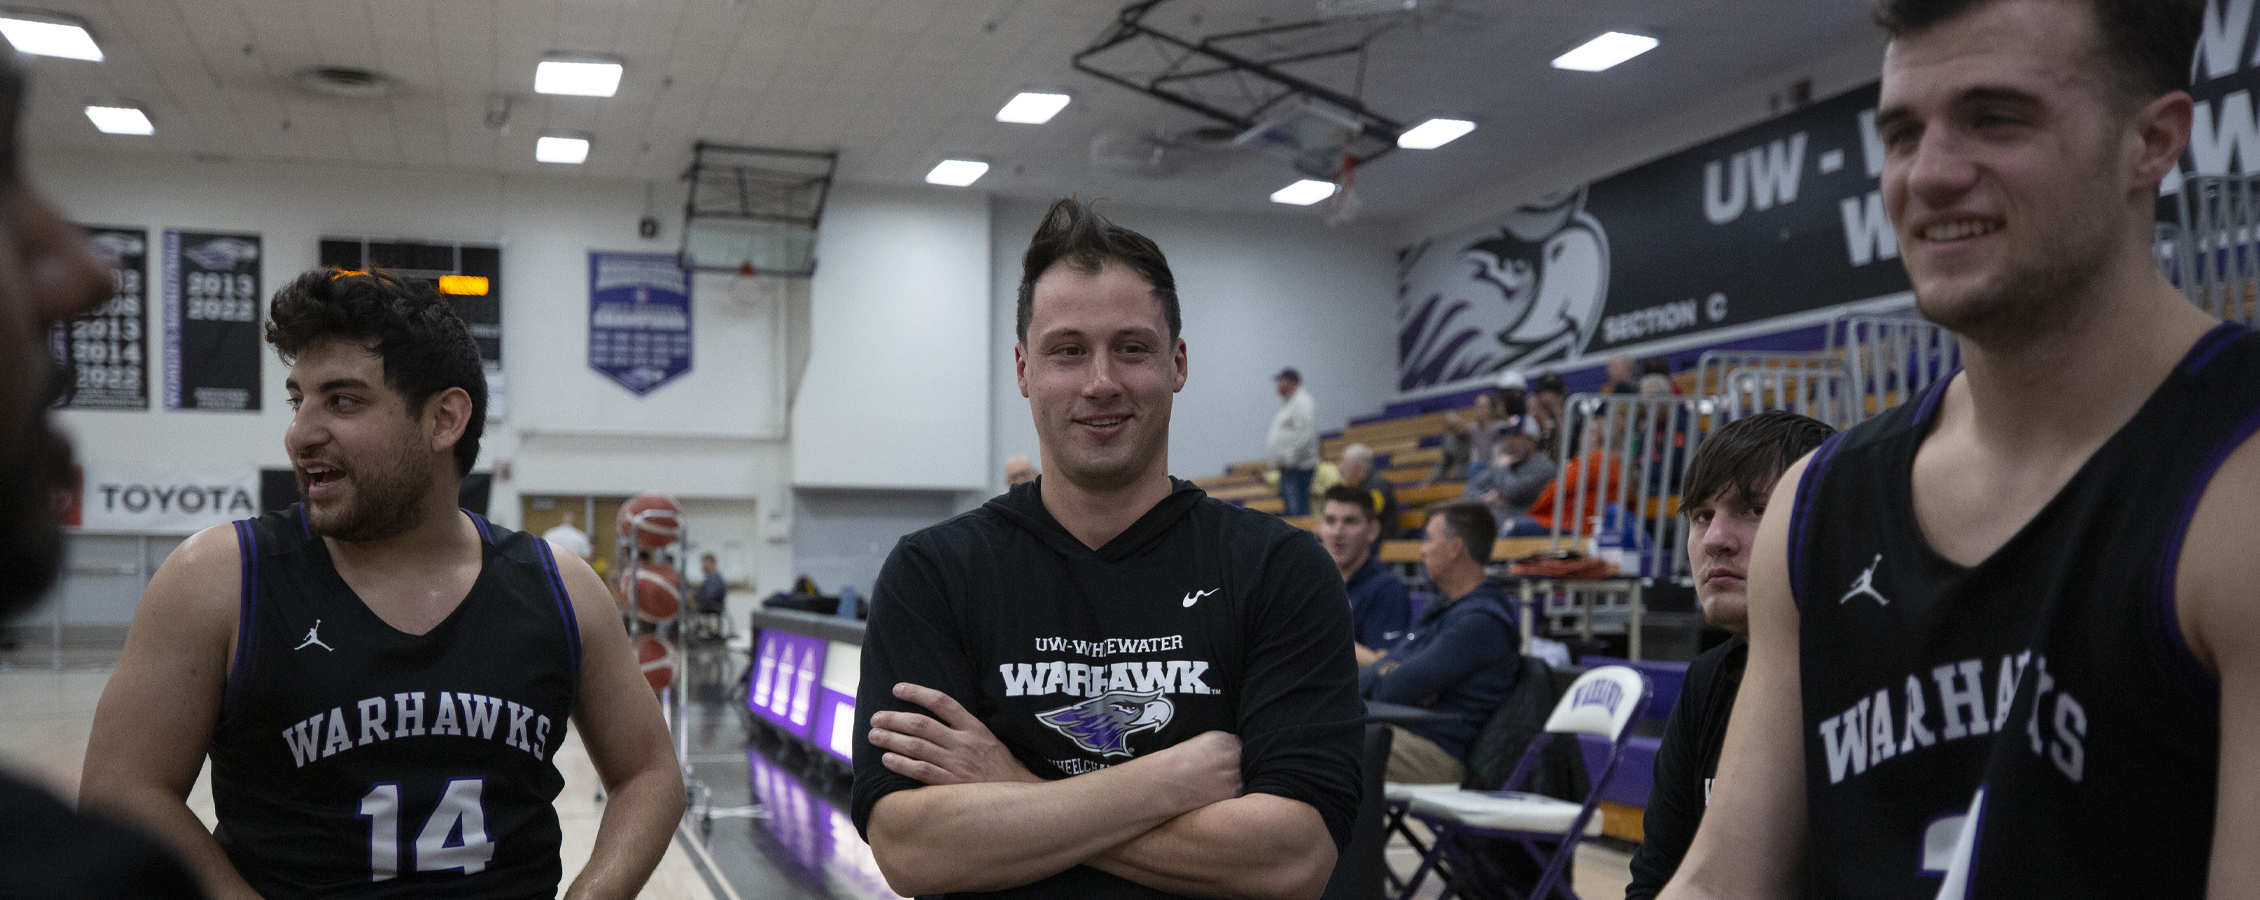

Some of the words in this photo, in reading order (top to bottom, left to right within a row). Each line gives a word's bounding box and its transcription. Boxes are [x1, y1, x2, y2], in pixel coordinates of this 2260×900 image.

[1703, 130, 1809, 225] UW
[186, 271, 255, 296] 2013
[1602, 299, 1698, 346] SECTION
[1704, 291, 1729, 323] C
[98, 483, 254, 513] TOYOTA
[1035, 634, 1183, 657] UW-WHEWATER
[282, 690, 551, 769] WARHAWKS
[1818, 648, 2088, 784] WARHAS
[355, 775, 499, 884] 14
